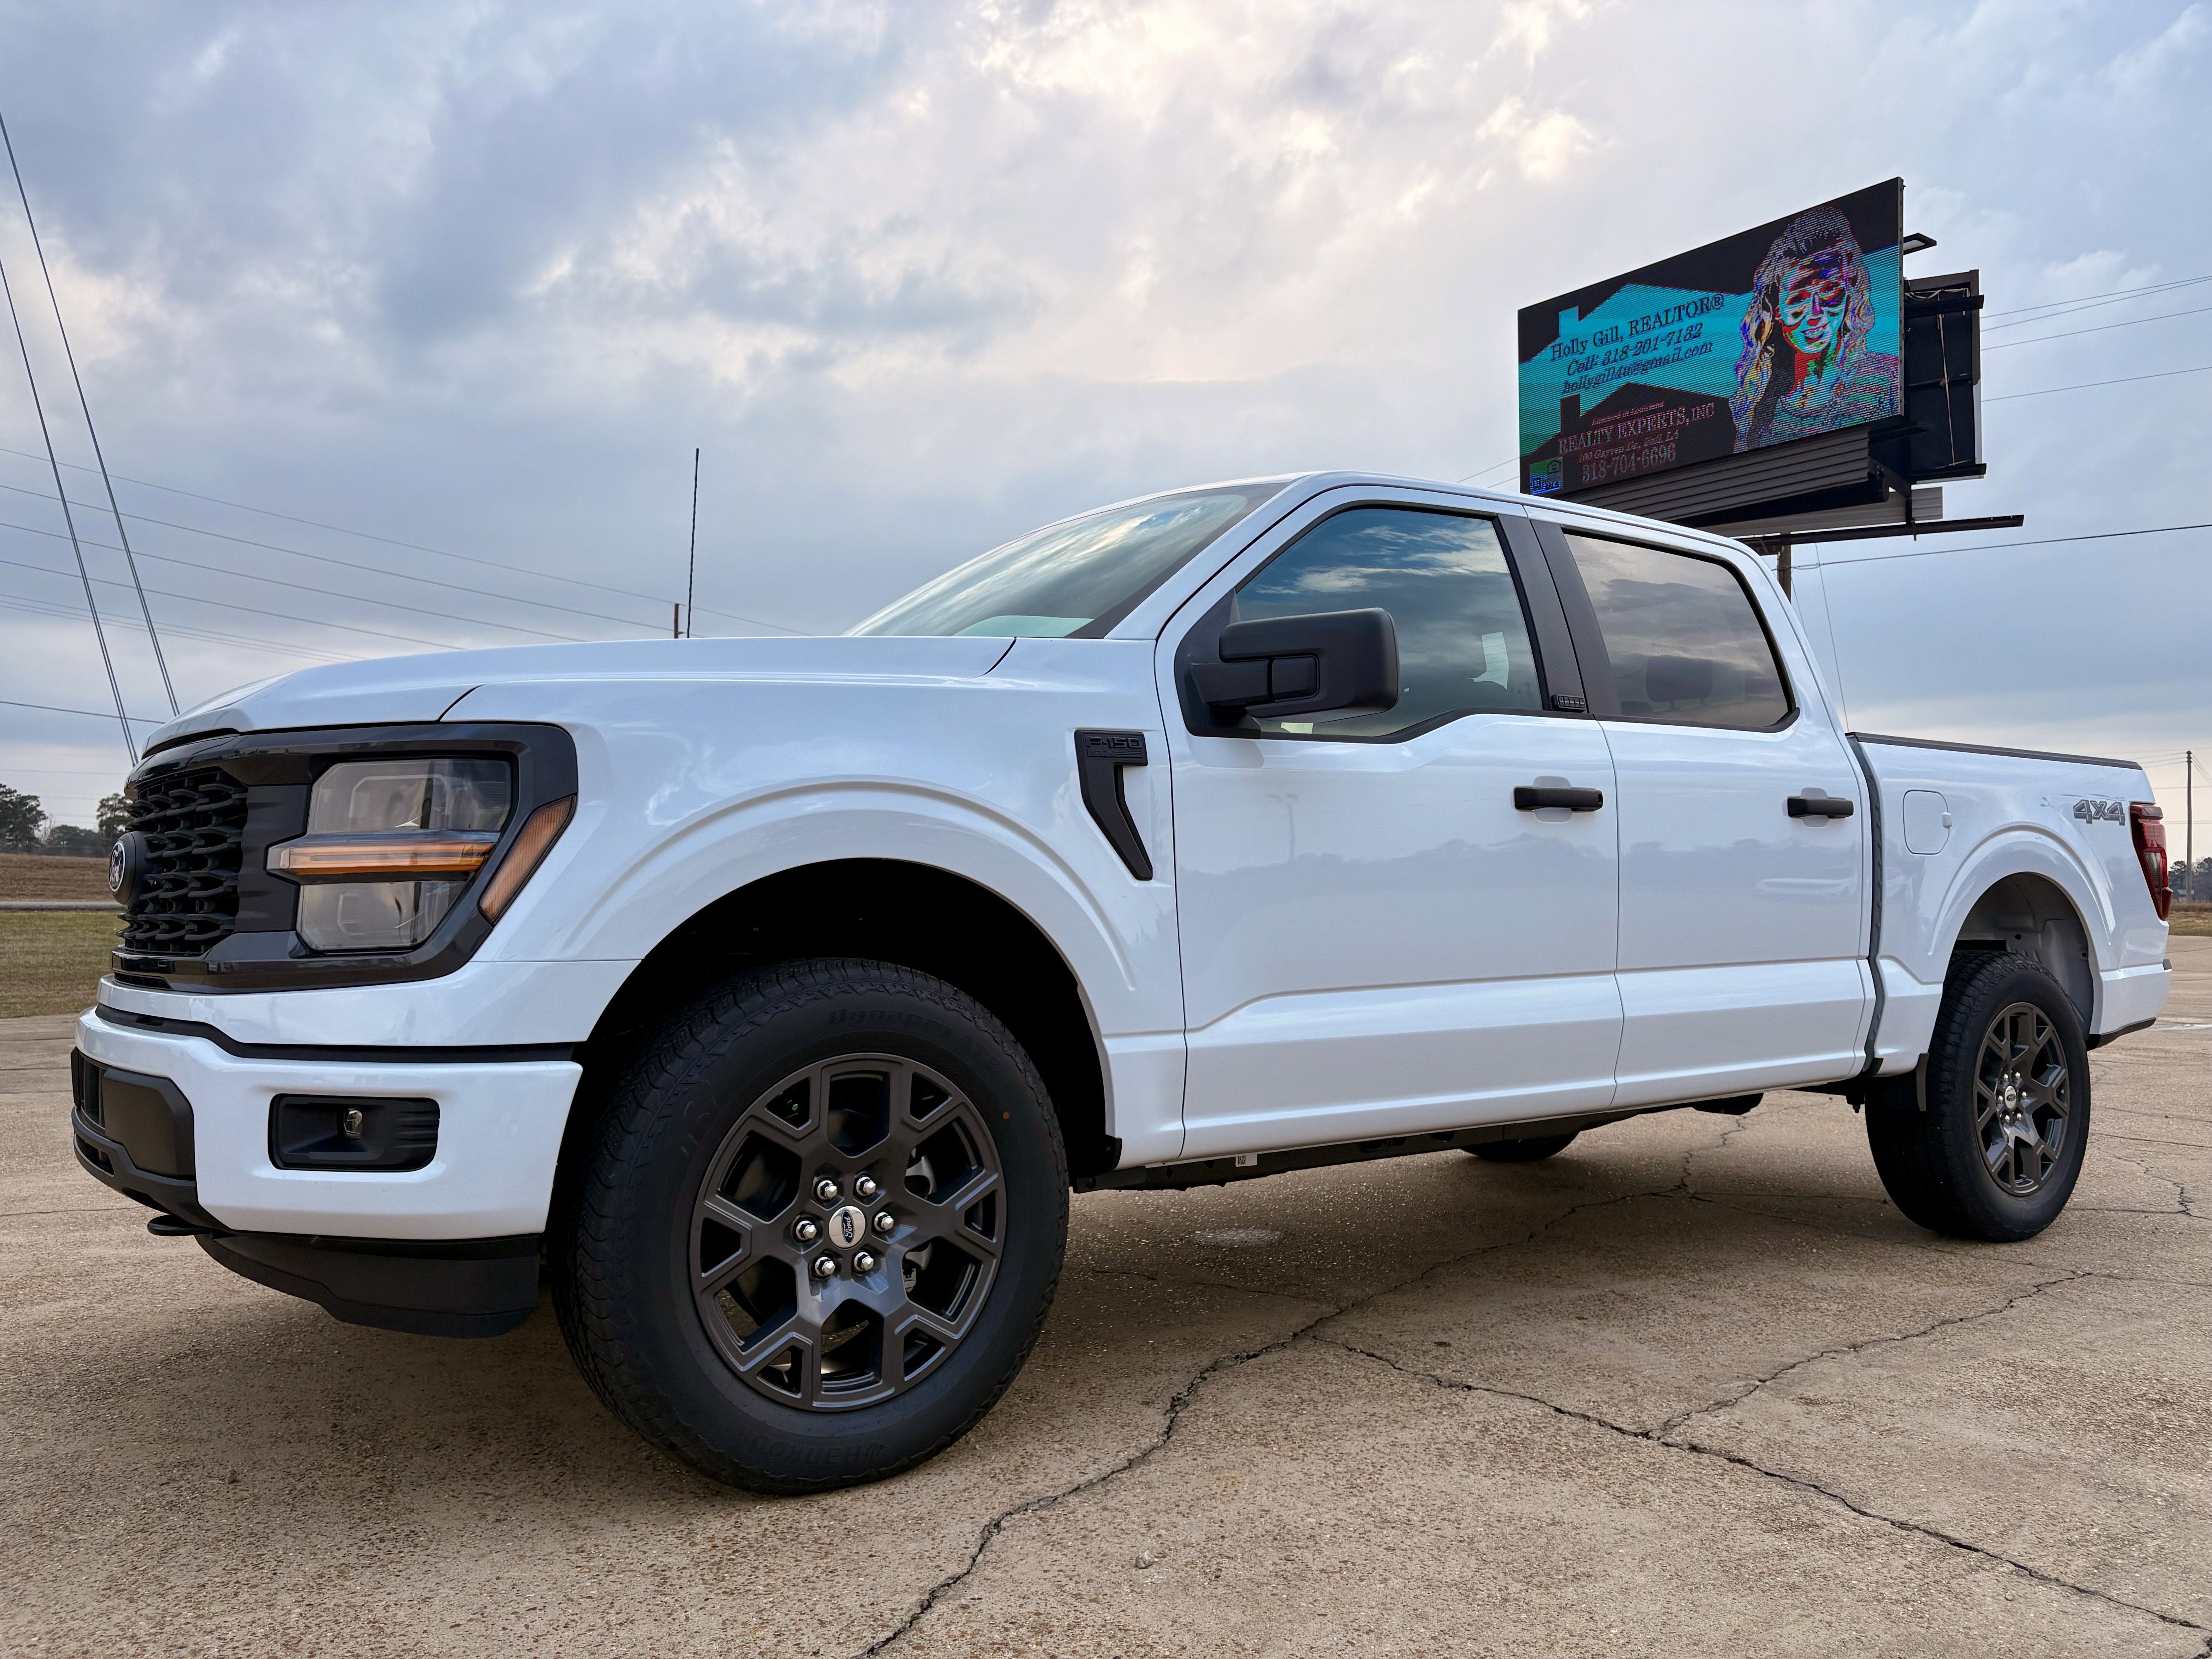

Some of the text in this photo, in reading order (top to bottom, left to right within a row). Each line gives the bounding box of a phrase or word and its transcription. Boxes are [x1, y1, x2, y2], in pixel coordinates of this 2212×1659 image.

[1551, 338, 1587, 361] Holly
[1594, 326, 1623, 347] Gill,
[1568, 323, 1703, 376] Cell: 318-201-7132
[1558, 425, 1614, 453] REALTY
[1583, 443, 1676, 481] 318-704-6696
[1085, 736, 1142, 749] F-150
[843, 1216, 853, 1238] Ford
